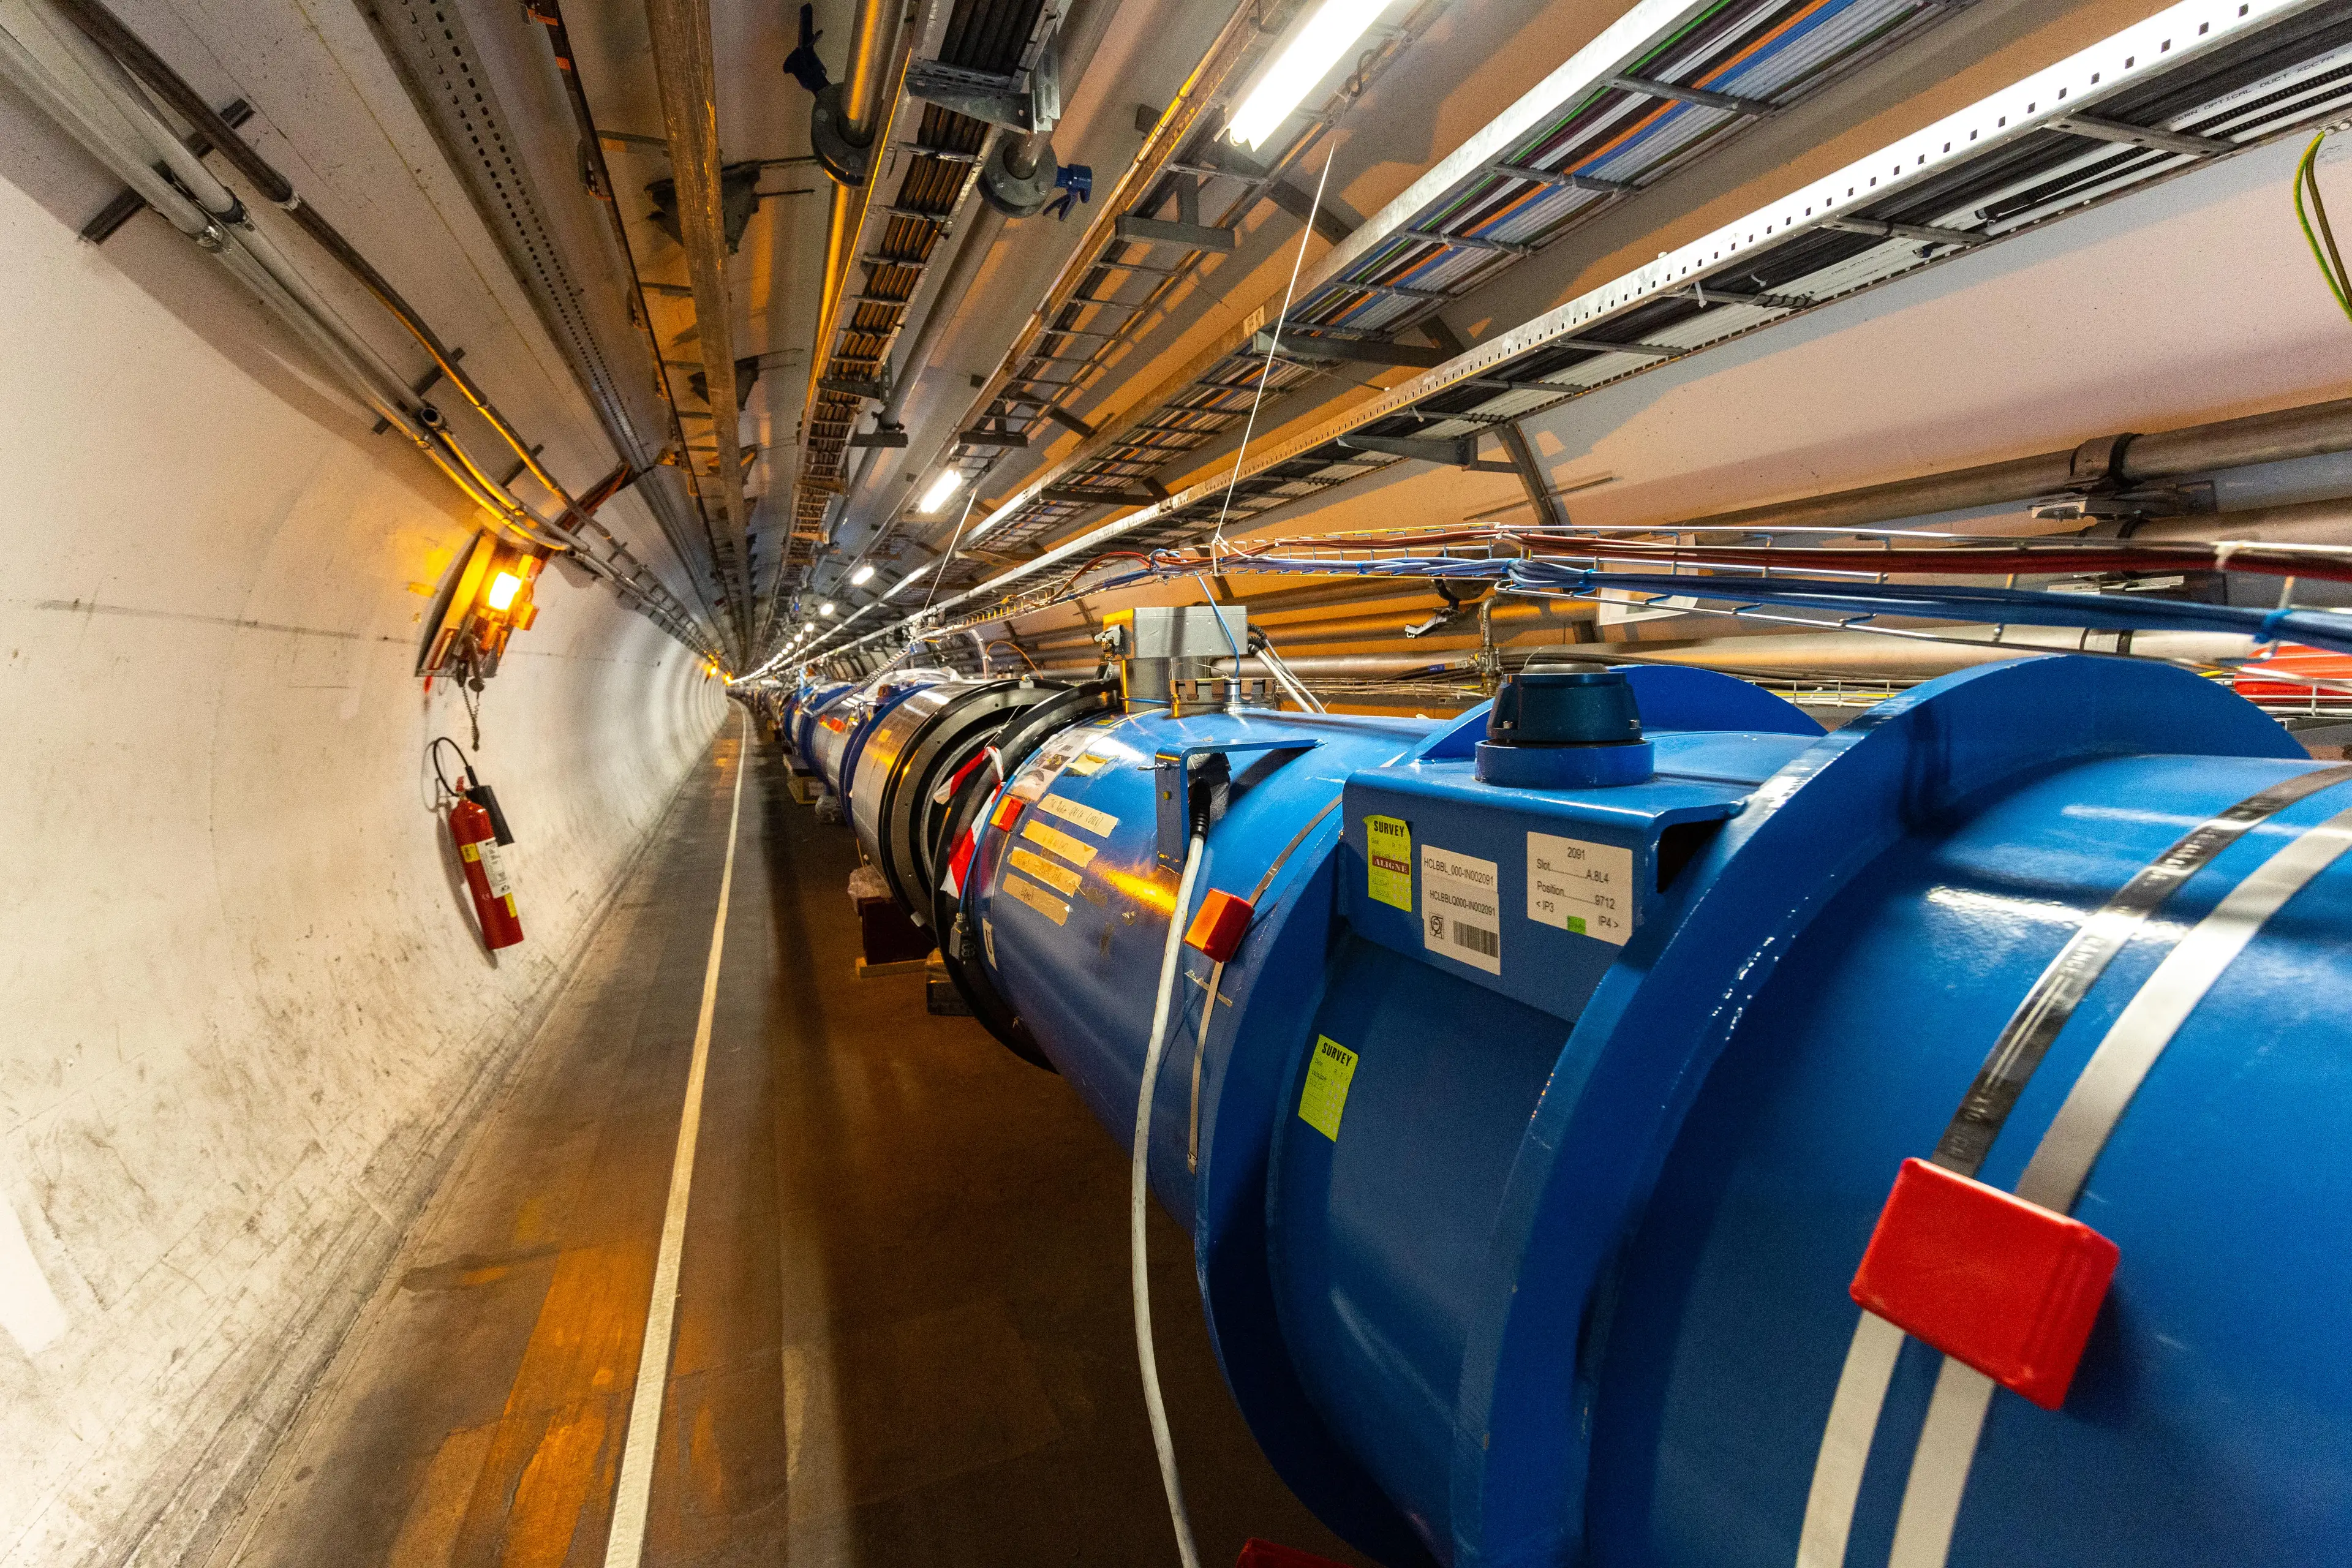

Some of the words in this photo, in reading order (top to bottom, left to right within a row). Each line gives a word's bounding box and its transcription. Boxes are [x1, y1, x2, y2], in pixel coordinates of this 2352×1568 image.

[2204, 89, 2253, 110] OPTICAL
[2259, 73, 2290, 88] DUCT
[1374, 820, 1404, 837] SURVEY
[1567, 847, 1585, 860] 2091
[1542, 900, 1555, 913] IP3
[1594, 894, 1616, 910] 9712
[1598, 914, 1612, 929] IP4
[1322, 1042, 1352, 1066] SURVEY
